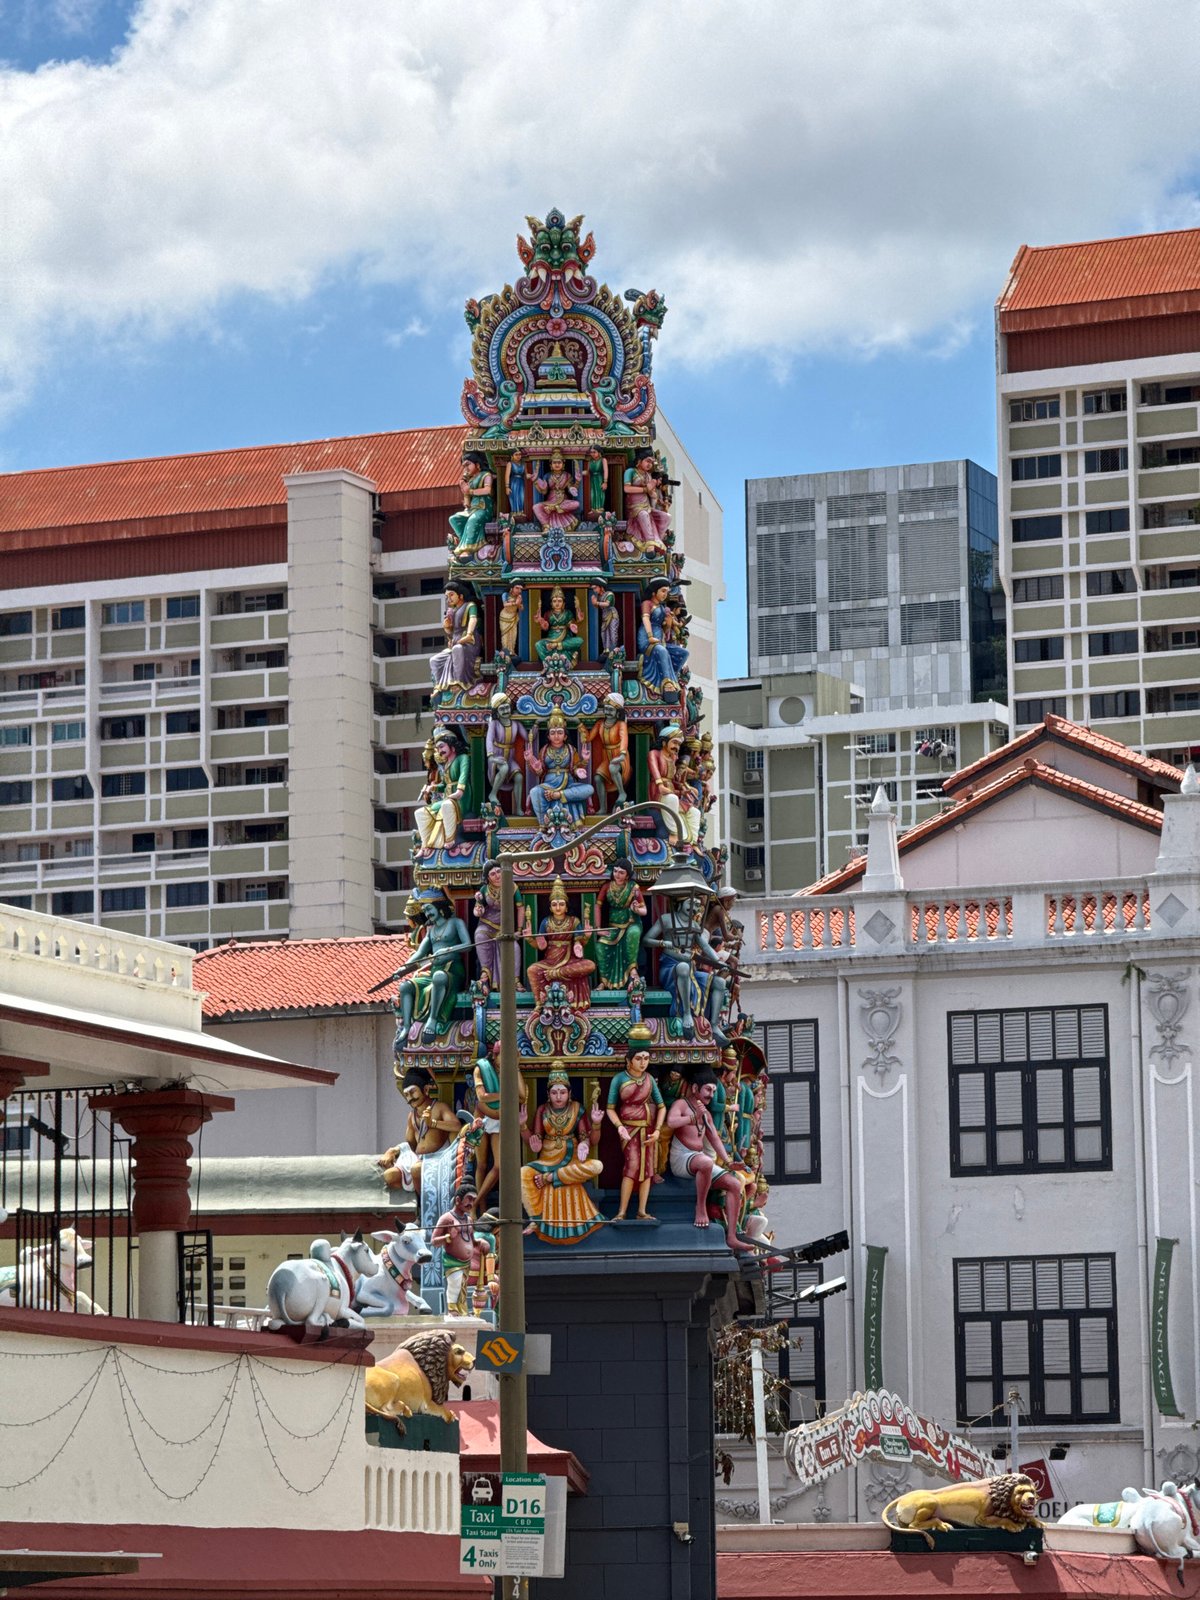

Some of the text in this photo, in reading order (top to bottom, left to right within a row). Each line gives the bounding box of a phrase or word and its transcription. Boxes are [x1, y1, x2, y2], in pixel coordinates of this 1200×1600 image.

[870, 1313, 878, 1389] VINTAG
[1157, 1306, 1168, 1398] VINTAGE
[506, 1498, 541, 1515] D16
[469, 1509, 495, 1523] Taxi
[480, 1529, 498, 1537] Stand
[462, 1545, 477, 1568] 4
[479, 1549, 499, 1558] Taxis
[478, 1560, 497, 1569] Only
